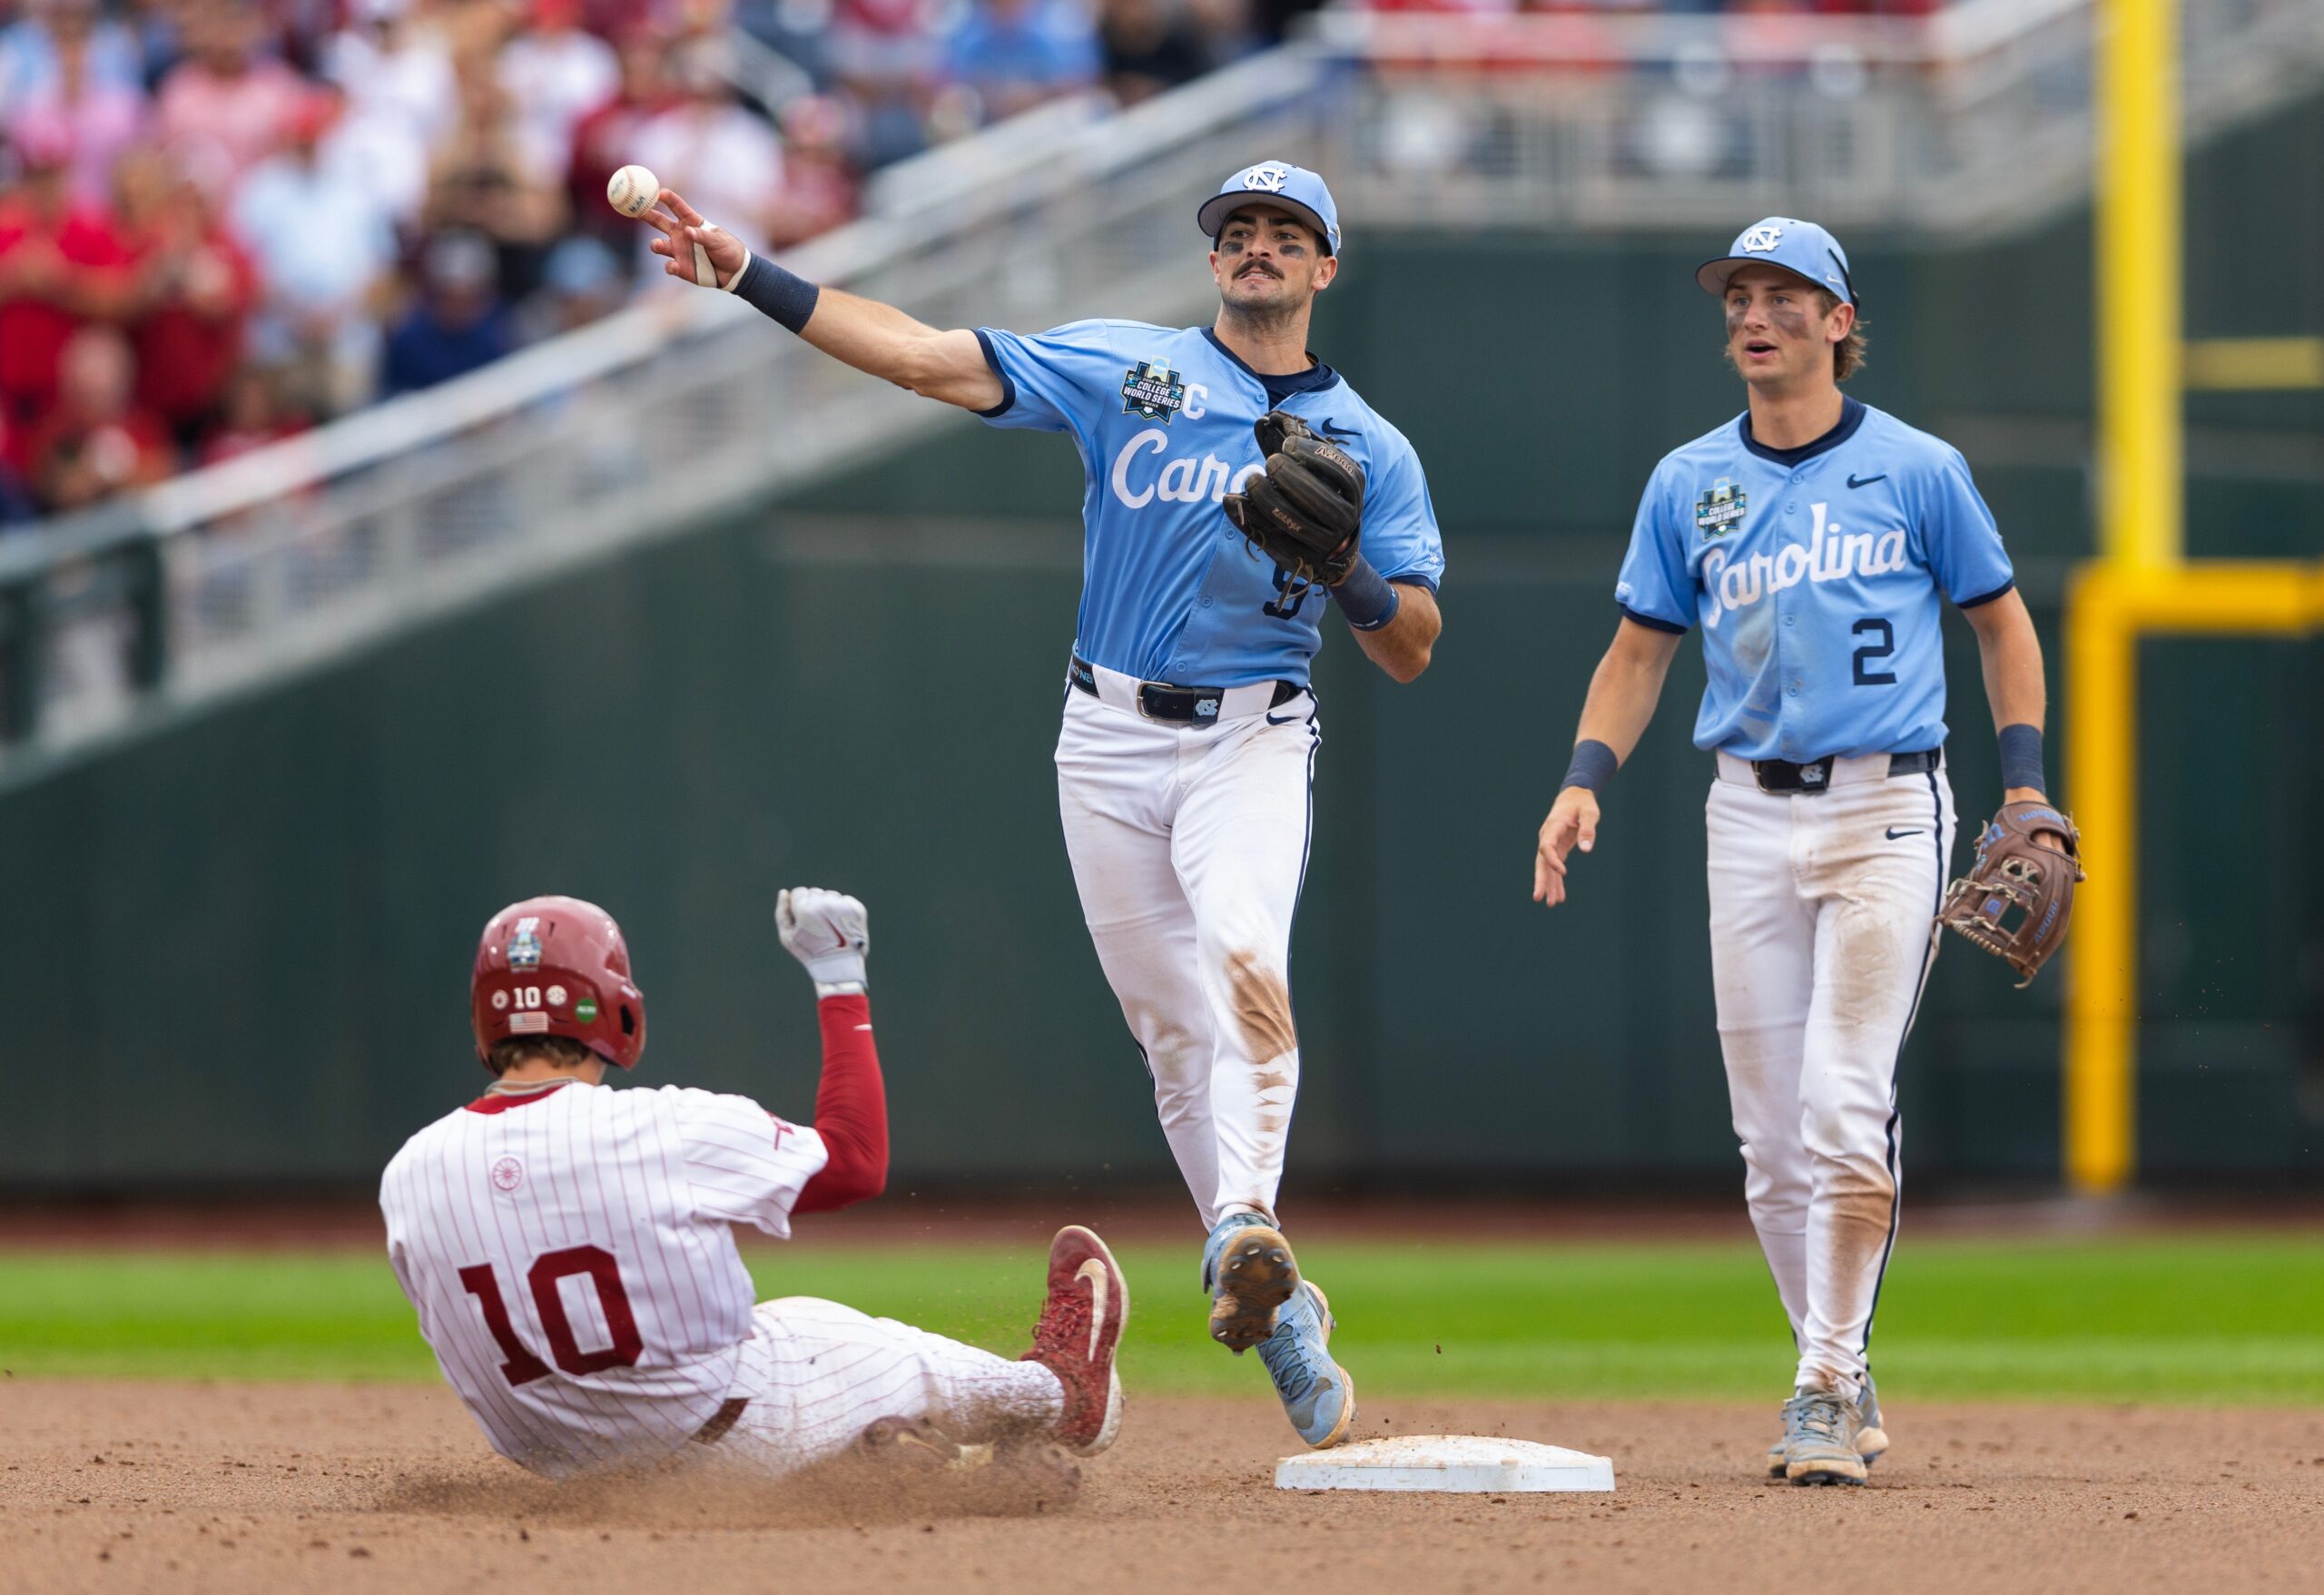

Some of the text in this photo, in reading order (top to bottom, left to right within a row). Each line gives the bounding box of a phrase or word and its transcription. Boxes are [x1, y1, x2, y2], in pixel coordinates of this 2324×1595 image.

[1124, 386, 1180, 409] WORLD SERIES
[1137, 380, 1171, 398] COLLEGE
[1183, 382, 1208, 420] C
[1702, 502, 1905, 629] Carolina
[1851, 617, 1897, 686] 2
[513, 986, 542, 1010] 10
[458, 1243, 645, 1388] 10
